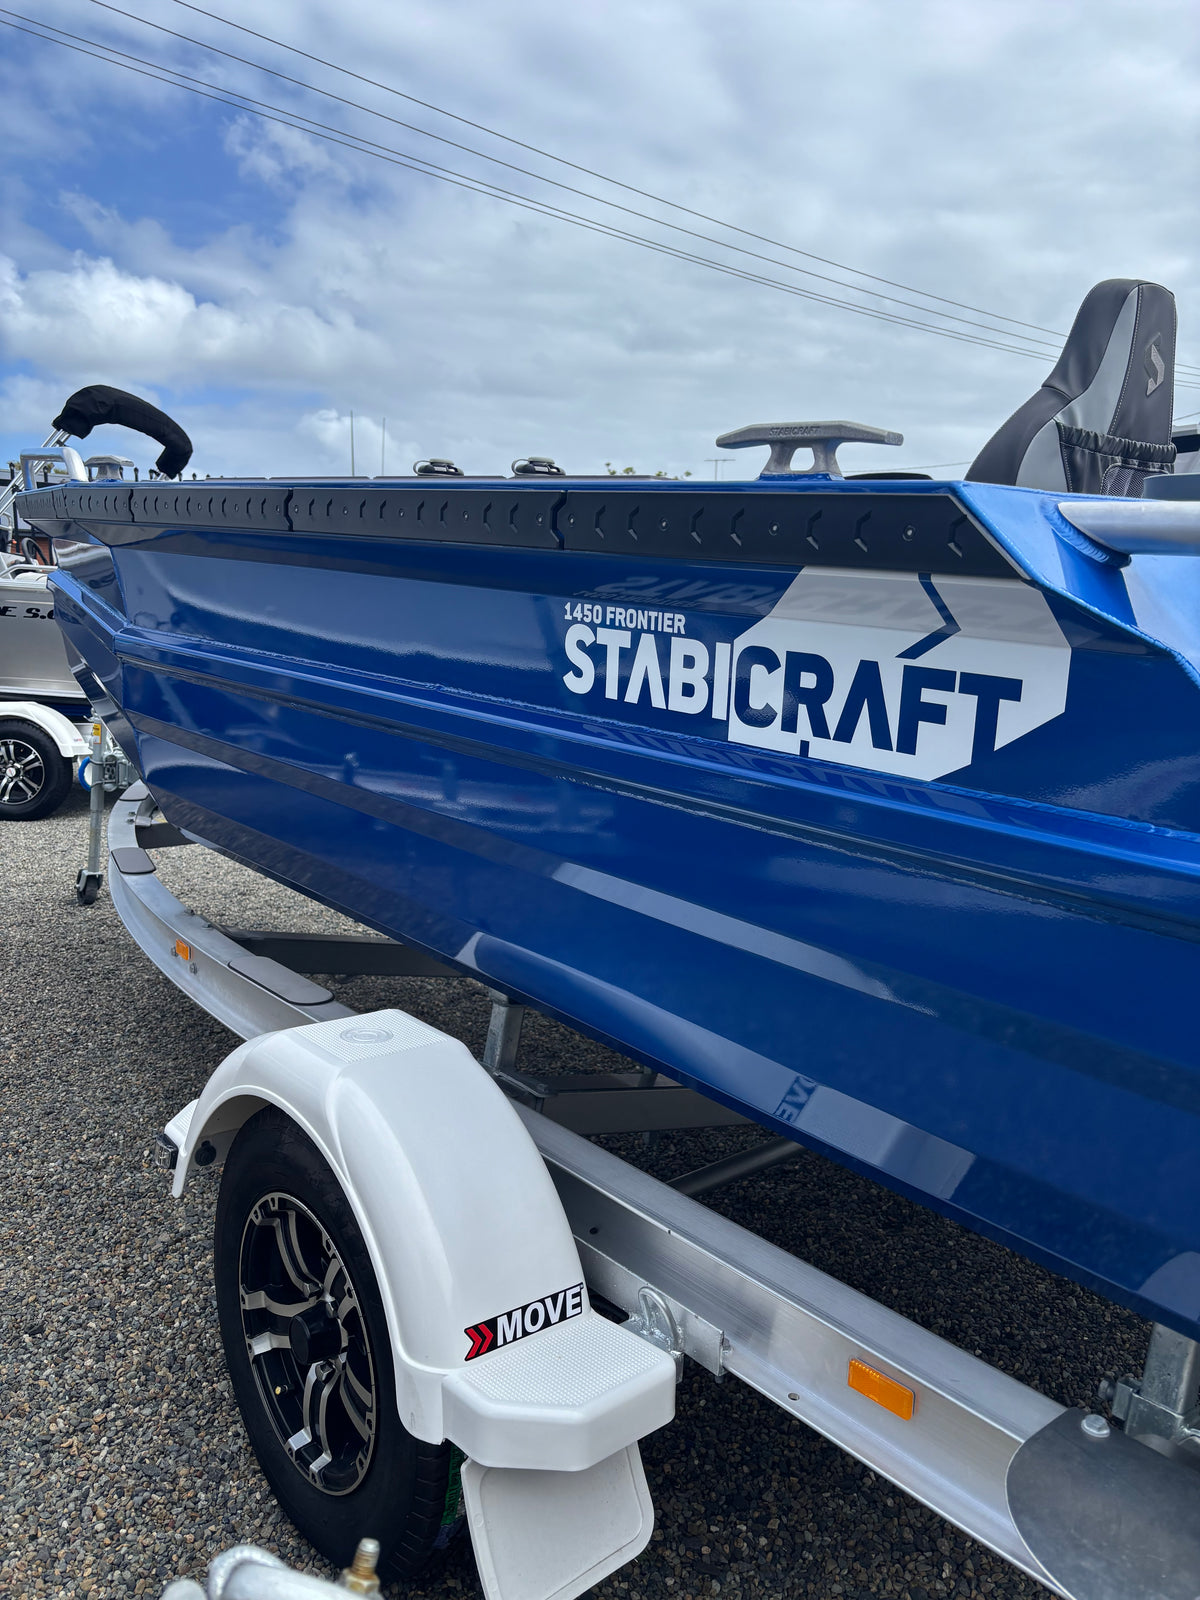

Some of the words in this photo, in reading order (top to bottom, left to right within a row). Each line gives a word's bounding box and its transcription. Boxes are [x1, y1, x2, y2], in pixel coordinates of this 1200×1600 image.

[769, 426, 820, 438] STABICRAFT
[564, 602, 602, 624] 1450
[605, 606, 686, 635] FRONTIER
[563, 623, 1023, 757] STABICRAFT
[497, 1285, 582, 1347] MOVE
